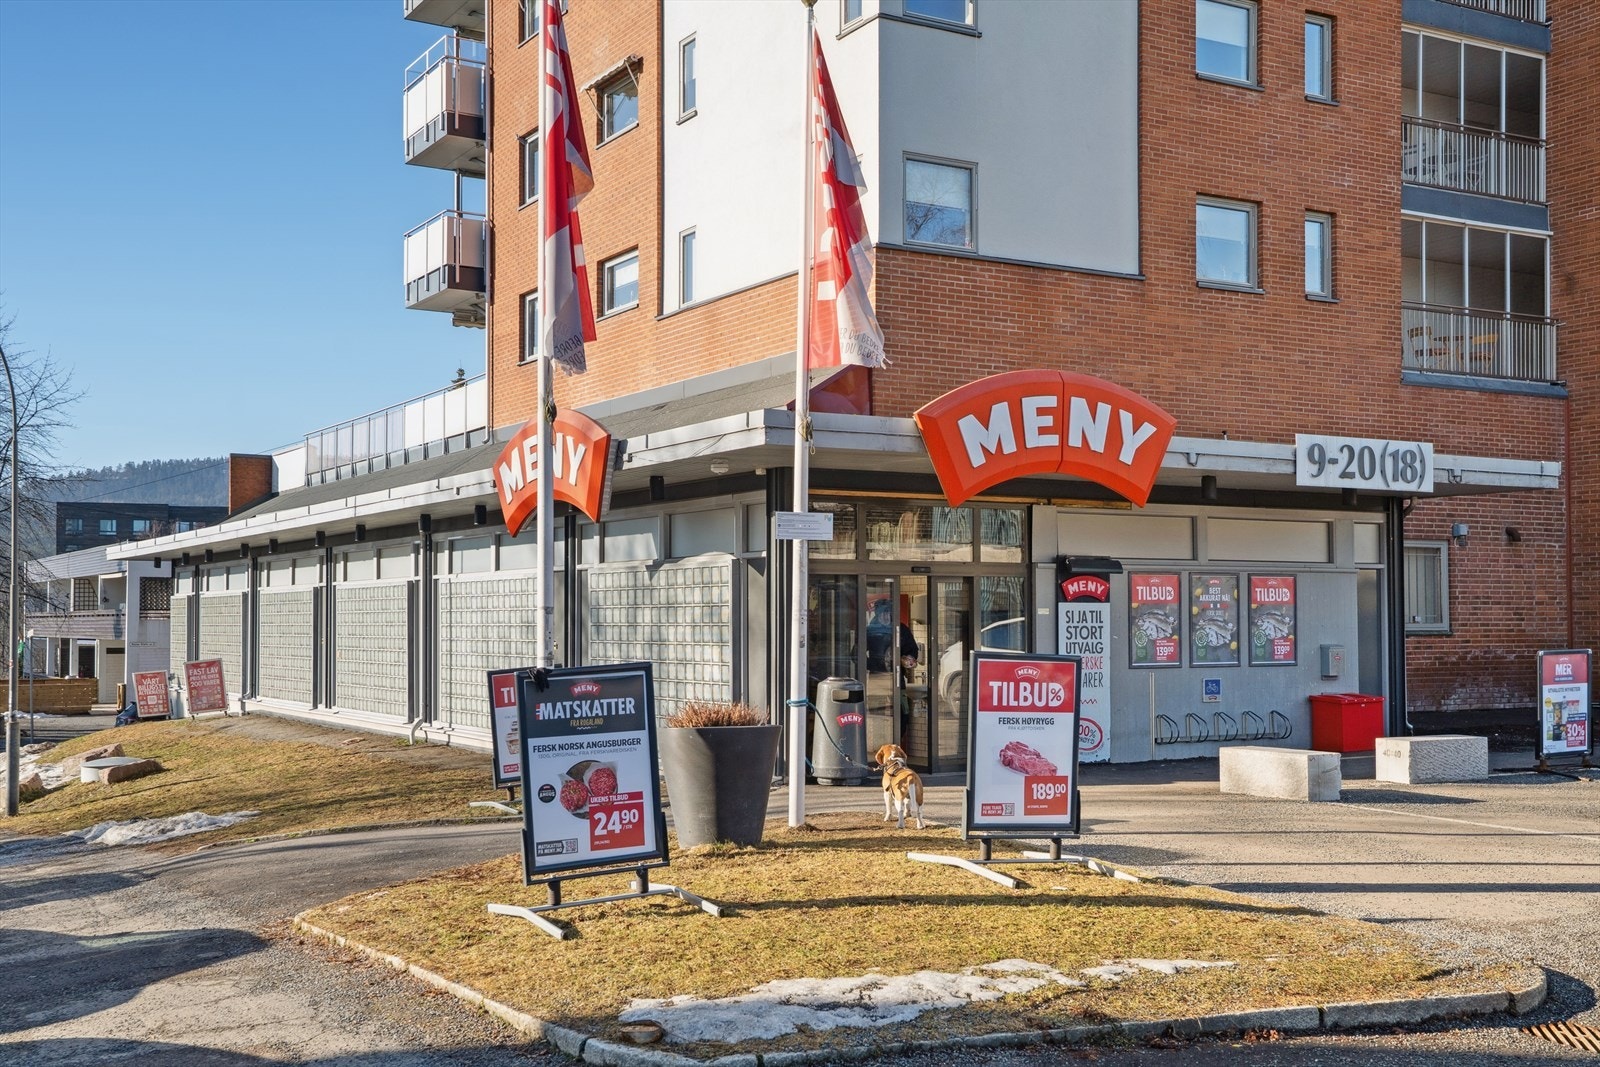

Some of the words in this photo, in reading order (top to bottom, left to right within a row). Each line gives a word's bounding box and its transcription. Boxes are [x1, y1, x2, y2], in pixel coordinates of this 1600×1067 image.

[957, 395, 1157, 468] MENY
[1067, 580, 1105, 595] MENY
[1136, 586, 1174, 600] TILBUD
[1255, 588, 1290, 602] TILBUD
[1065, 610, 1075, 624] SI
[1077, 610, 1088, 624] JA
[1088, 610, 1104, 624] TIL
[1065, 625, 1104, 640] STORT
[1065, 641, 1104, 655] UTVALG
[1081, 656, 1103, 670] ERSKE
[189, 668, 205, 676] FAST
[1017, 668, 1038, 676] MENY
[1082, 671, 1104, 688] ARER
[574, 684, 599, 694] MENY
[988, 681, 1065, 707] TILBUD
[540, 697, 636, 720] MATSKATTER
[570, 719, 580, 727] FRA
[580, 717, 604, 727] ROGALAND
[840, 715, 862, 723] MENY
[998, 717, 1021, 725] FERSK
[1021, 717, 1055, 725] HØYRYGG
[1079, 725, 1097, 738] 00%
[533, 744, 558, 753] FERSK
[558, 742, 585, 751] NORSK
[586, 738, 642, 749] ANGUSBURGER
